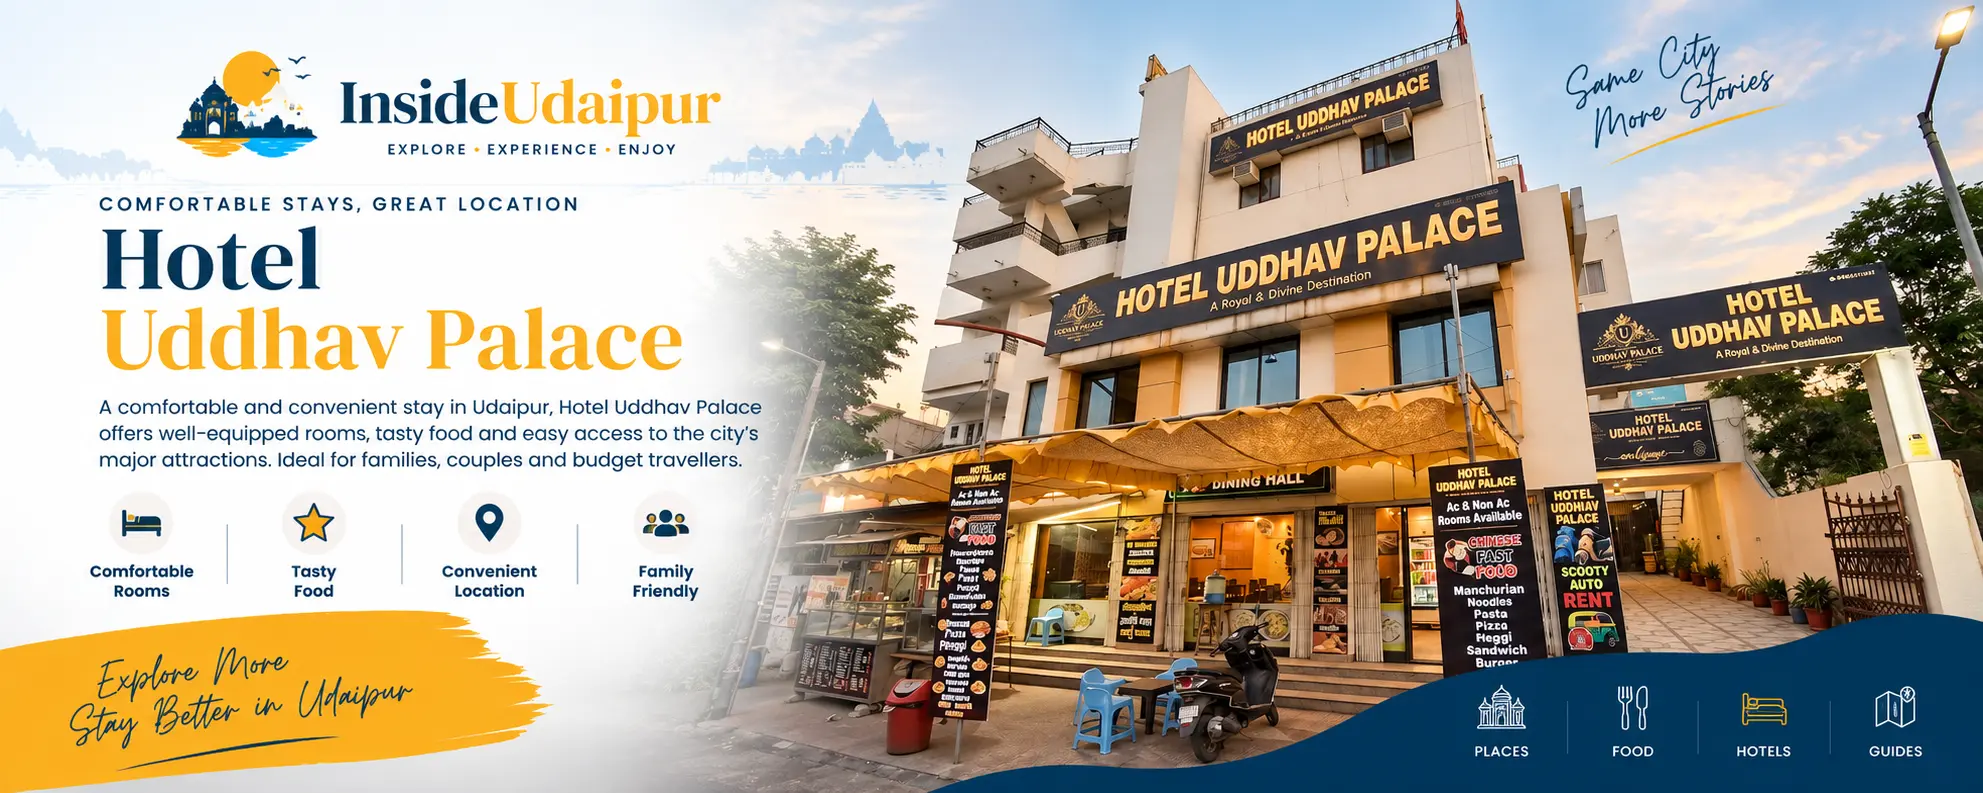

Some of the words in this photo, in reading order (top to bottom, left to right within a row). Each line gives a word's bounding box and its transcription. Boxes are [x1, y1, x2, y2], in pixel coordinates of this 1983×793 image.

[1246, 120, 1293, 148] HOTEL
[1297, 95, 1360, 131] UDDHAV
[1364, 72, 1430, 109] PALACE
[1115, 271, 1208, 318] HOTEL
[1216, 236, 1347, 294] UDDHAV
[1357, 199, 1503, 264] PALACE
[1210, 301, 1218, 312] A
[1256, 292, 1264, 302] &
[1268, 284, 1303, 299] Divine
[1307, 270, 1372, 291] Destination
[1725, 283, 1813, 316] HOTEL
[1671, 314, 1771, 350] UDDHAV
[1779, 298, 1885, 336] PALACE
[1715, 350, 1724, 359] A
[1725, 347, 1750, 360] Royal
[1752, 345, 1760, 355] &
[1761, 341, 1789, 353] Divine
[1790, 334, 1843, 350] Destination
[1635, 412, 1672, 426] HOTEL
[1609, 425, 1654, 439] UDDHAV
[1657, 420, 1703, 434] PALACE
[1457, 466, 1491, 479] HOTEL
[1212, 475, 1261, 490] DINING
[1265, 472, 1305, 486] HALL
[1436, 479, 1475, 492] UDDHAV
[1478, 476, 1517, 488] PALACE
[1553, 488, 1594, 501] HOTEL
[1446, 502, 1460, 512] Ac
[1462, 501, 1470, 511] &
[1472, 500, 1493, 510] Non
[1496, 498, 1510, 508] Ac
[1437, 515, 1471, 526] Rooms
[1556, 513, 1599, 525] PALACE
[1476, 548, 1514, 563] FAST
[1561, 565, 1609, 578] SCOOTY
[1453, 583, 1525, 596] Manchurian
[1570, 578, 1603, 590] AUTO
[1467, 597, 1513, 607] Noodles
[1563, 591, 1613, 608] RENT
[1474, 609, 1508, 619] Pasta
[1466, 644, 1528, 655] Sandwich
